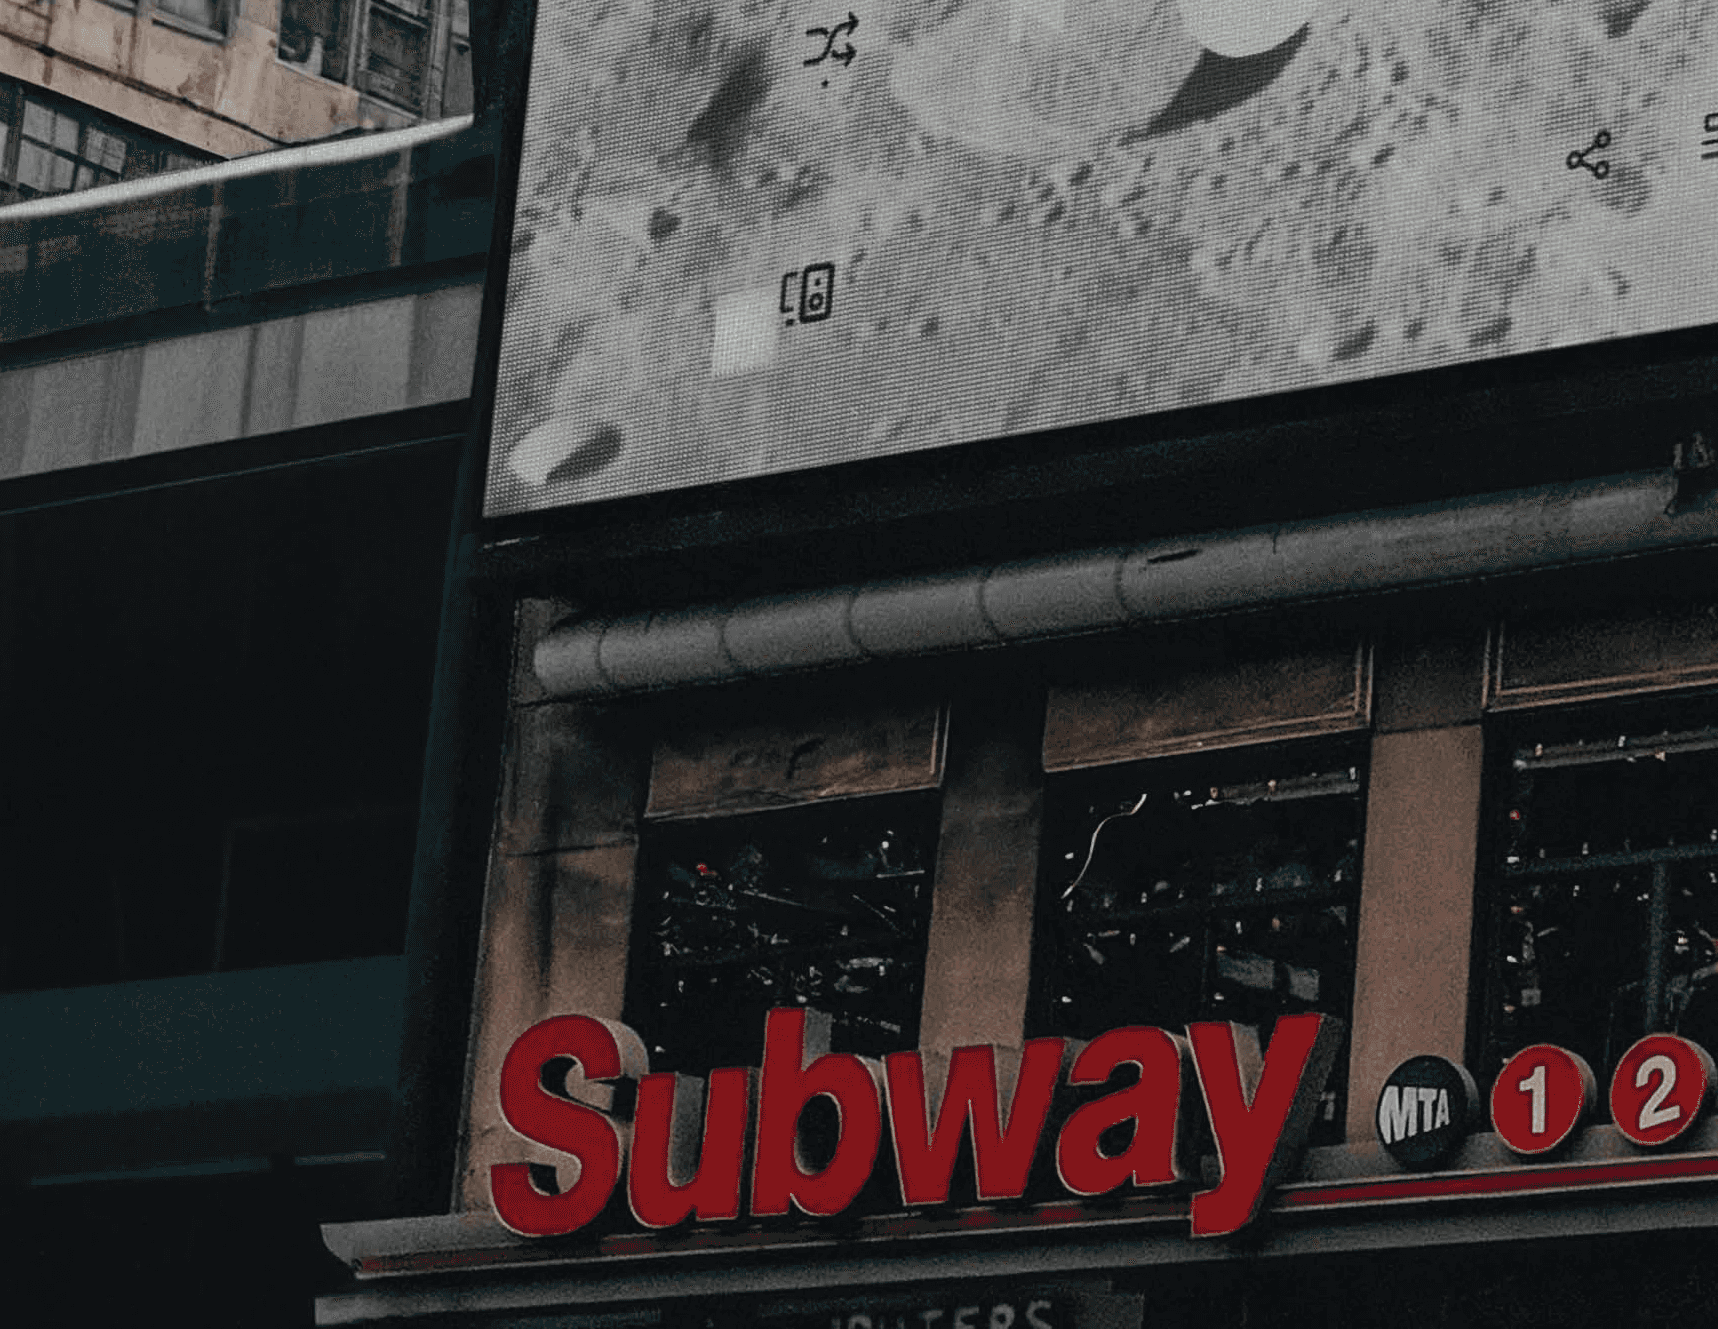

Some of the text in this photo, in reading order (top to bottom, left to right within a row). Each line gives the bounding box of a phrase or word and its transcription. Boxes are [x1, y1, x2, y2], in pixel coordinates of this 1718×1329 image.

[487, 1004, 1325, 1239] Subway
[1376, 1080, 1453, 1145] MTA
[1518, 1063, 1547, 1136] 1
[1634, 1054, 1682, 1130] 2
